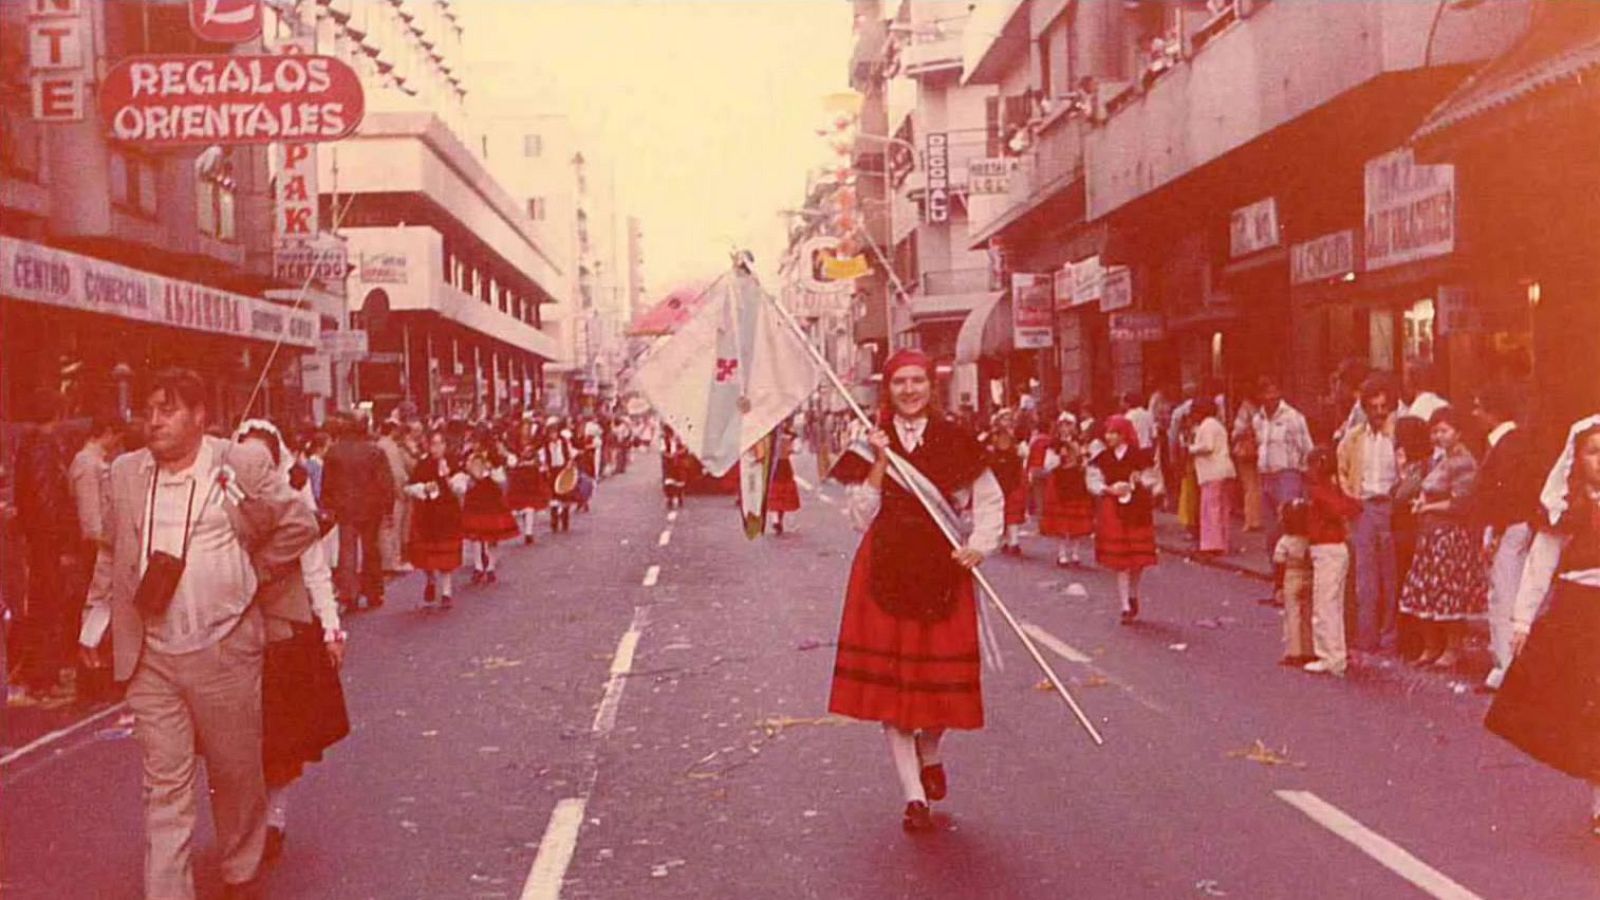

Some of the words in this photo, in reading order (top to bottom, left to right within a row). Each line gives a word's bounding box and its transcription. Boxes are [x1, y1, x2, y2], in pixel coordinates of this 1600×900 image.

[130, 58, 331, 97] REGALOS
[113, 102, 346, 140] ORIENTALES
[14, 254, 70, 296] CENTRO
